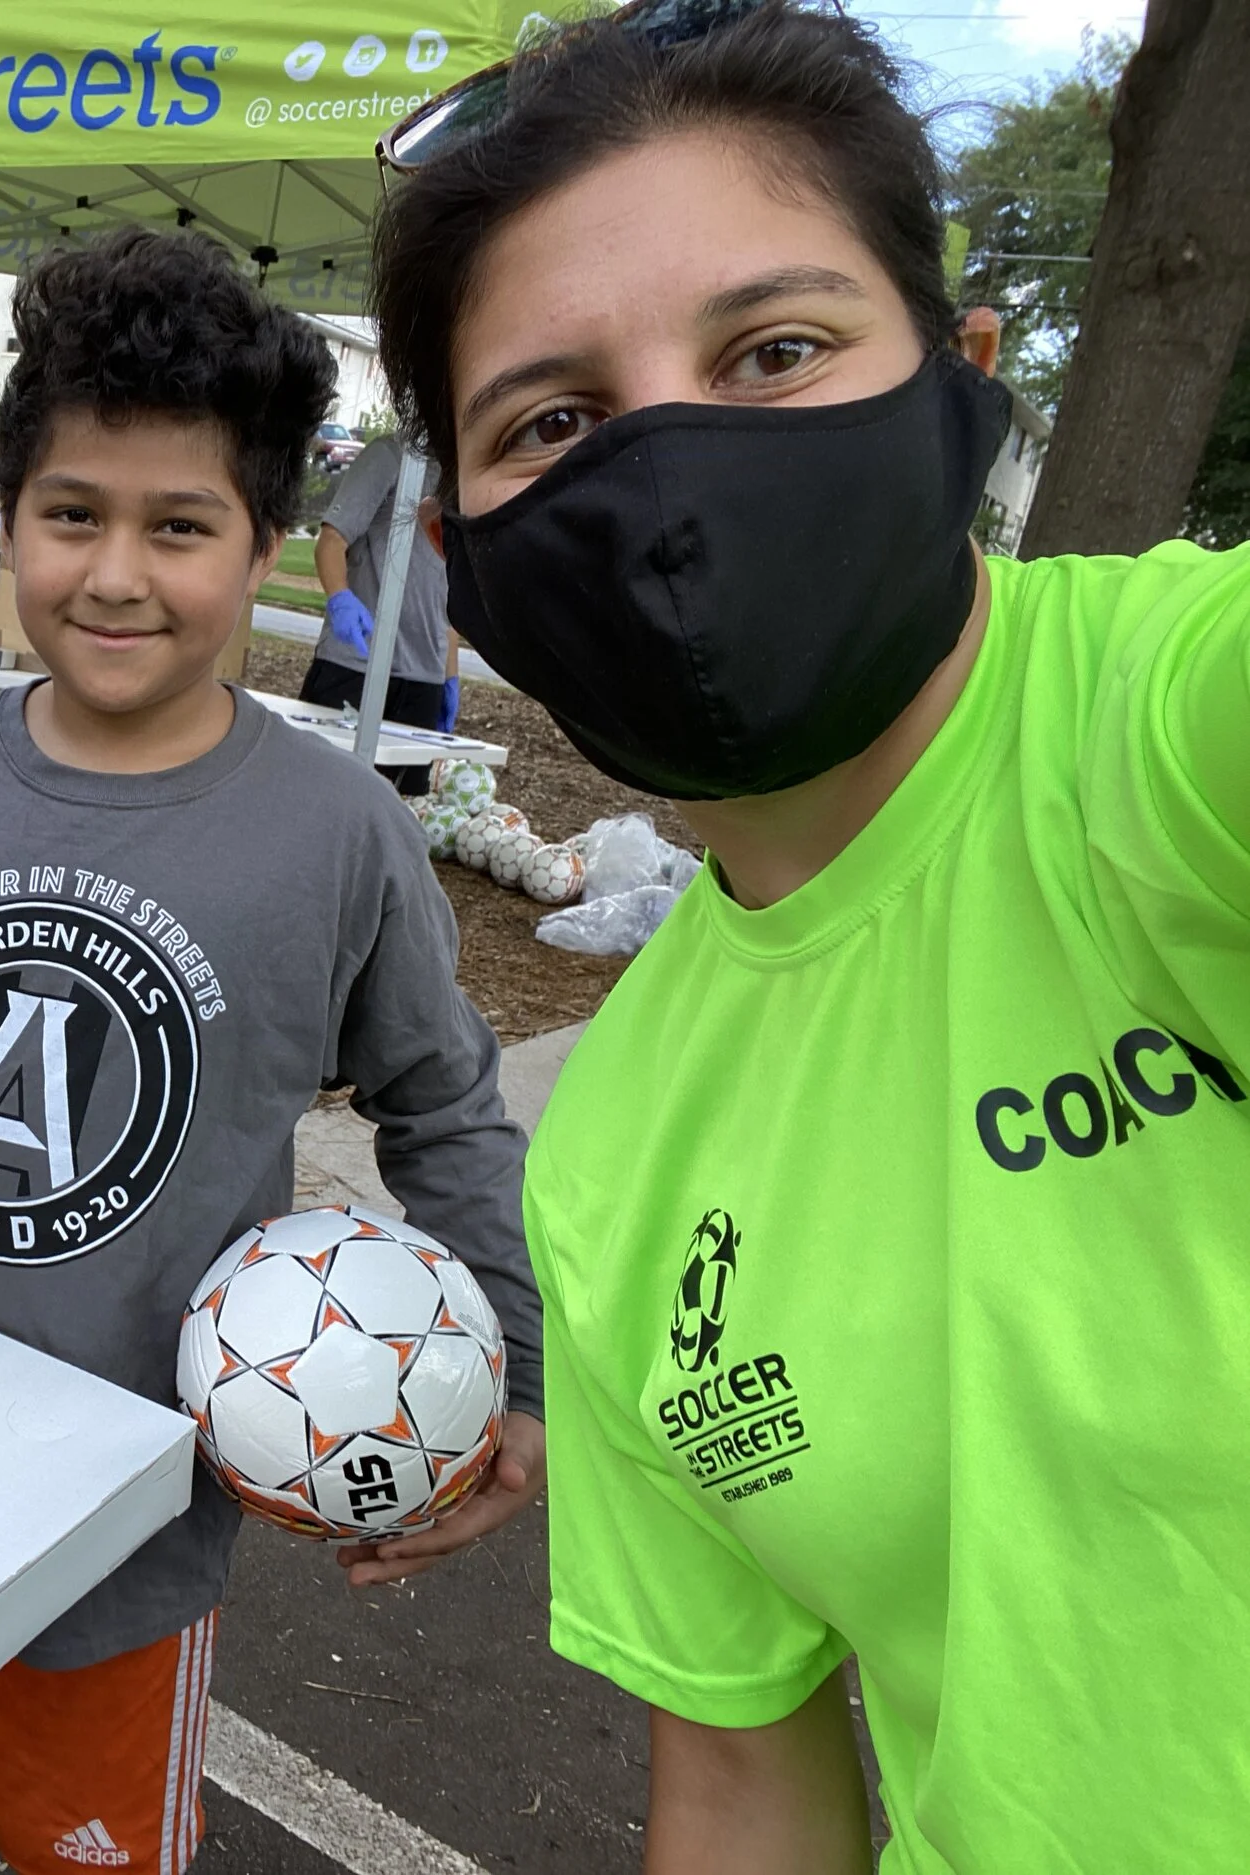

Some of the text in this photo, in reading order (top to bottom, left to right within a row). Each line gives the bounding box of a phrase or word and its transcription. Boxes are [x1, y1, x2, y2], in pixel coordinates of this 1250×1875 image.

[28, 865, 65, 893] IN
[74, 869, 135, 913] THE
[130, 898, 226, 1022] STREETS
[83, 933, 168, 1016] HILLS
[52, 1185, 130, 1242] 19-20
[658, 1352, 793, 1441] SOCCER
[695, 1407, 805, 1475] STREETS
[342, 1454, 399, 1523] SEL
[768, 1467, 794, 1487] 1989
[54, 1842, 130, 1866] adidas
